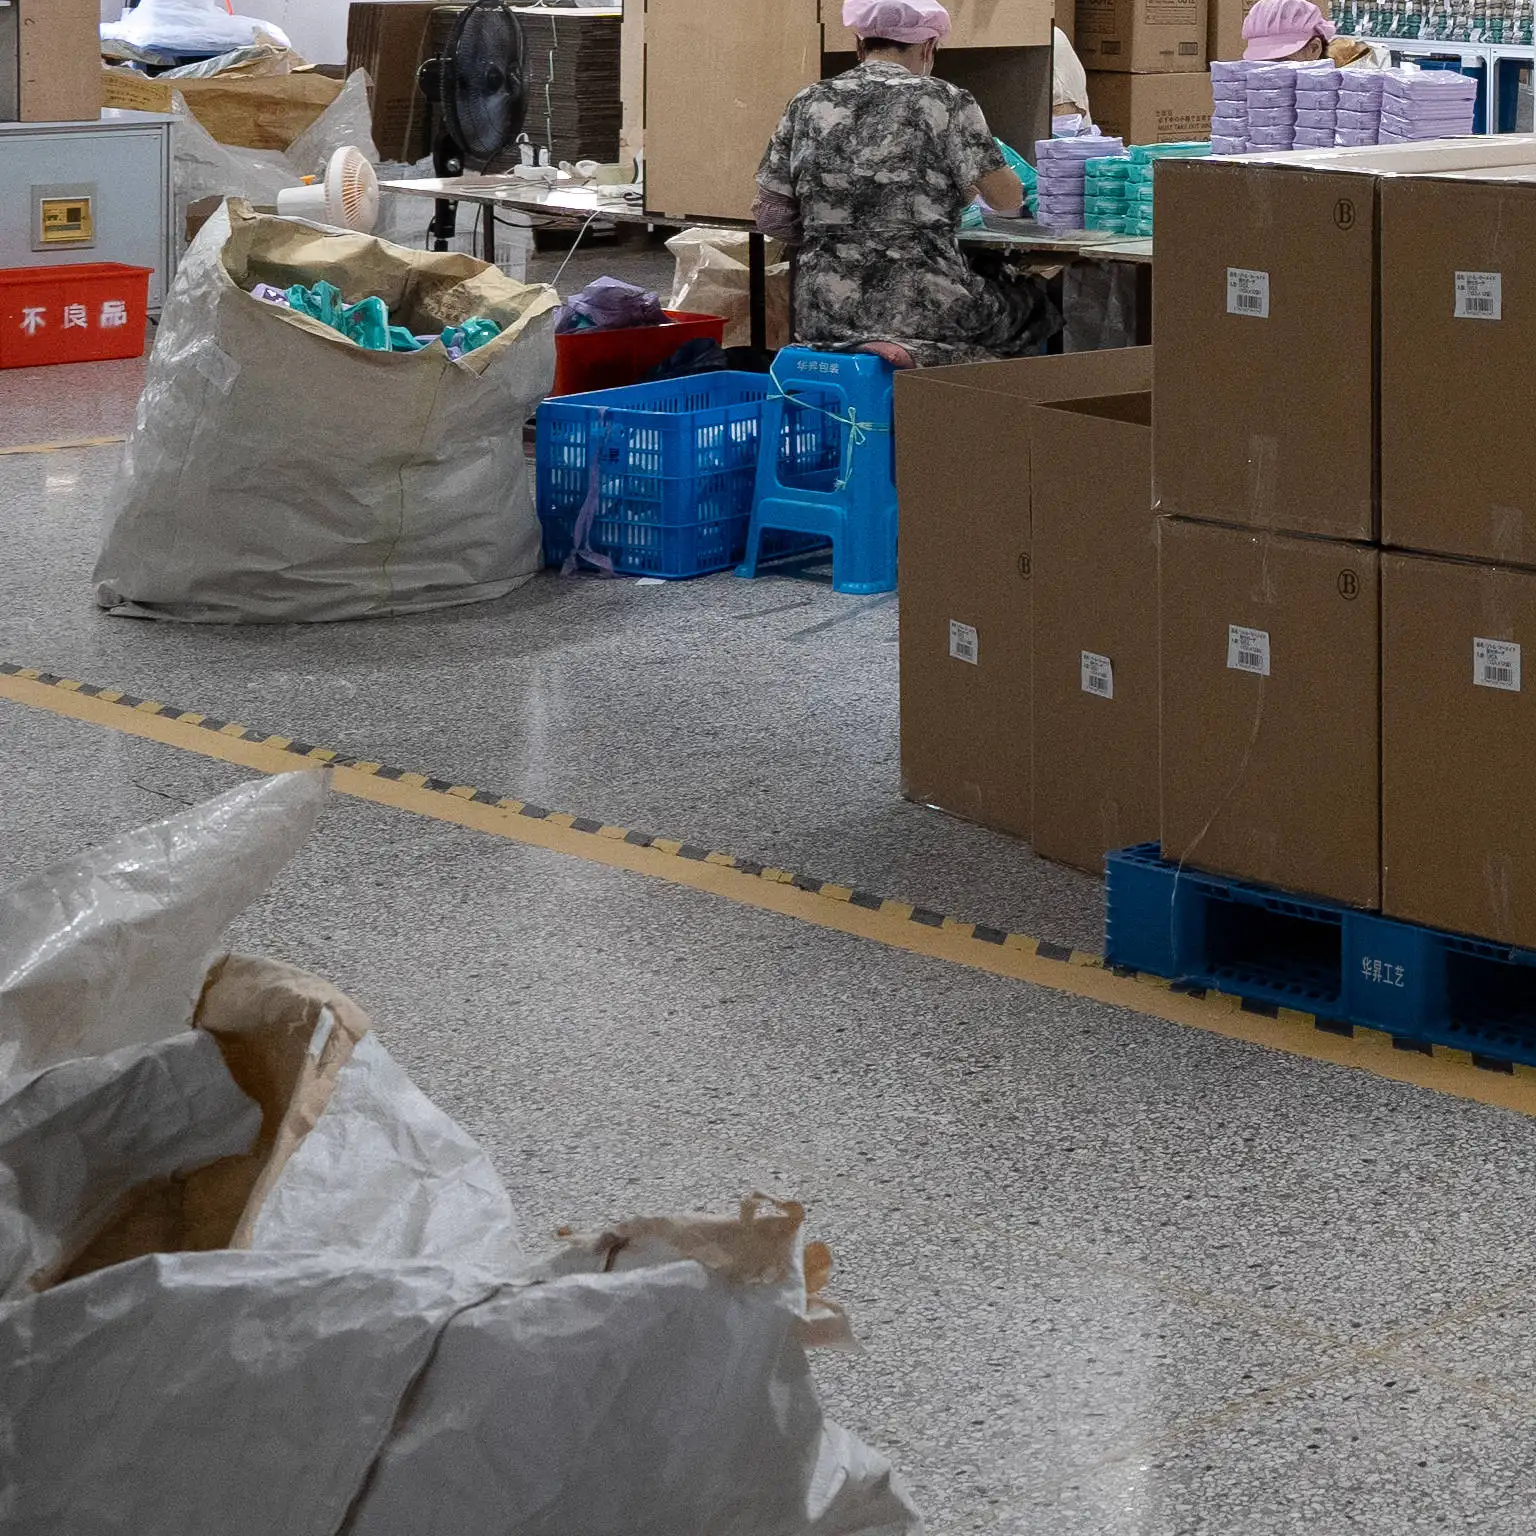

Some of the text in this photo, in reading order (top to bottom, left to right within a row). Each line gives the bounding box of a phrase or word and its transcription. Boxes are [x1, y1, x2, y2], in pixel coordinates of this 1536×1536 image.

[20, 300, 127, 335] 不良品
[1361, 956, 1405, 988] 华昇工艺
